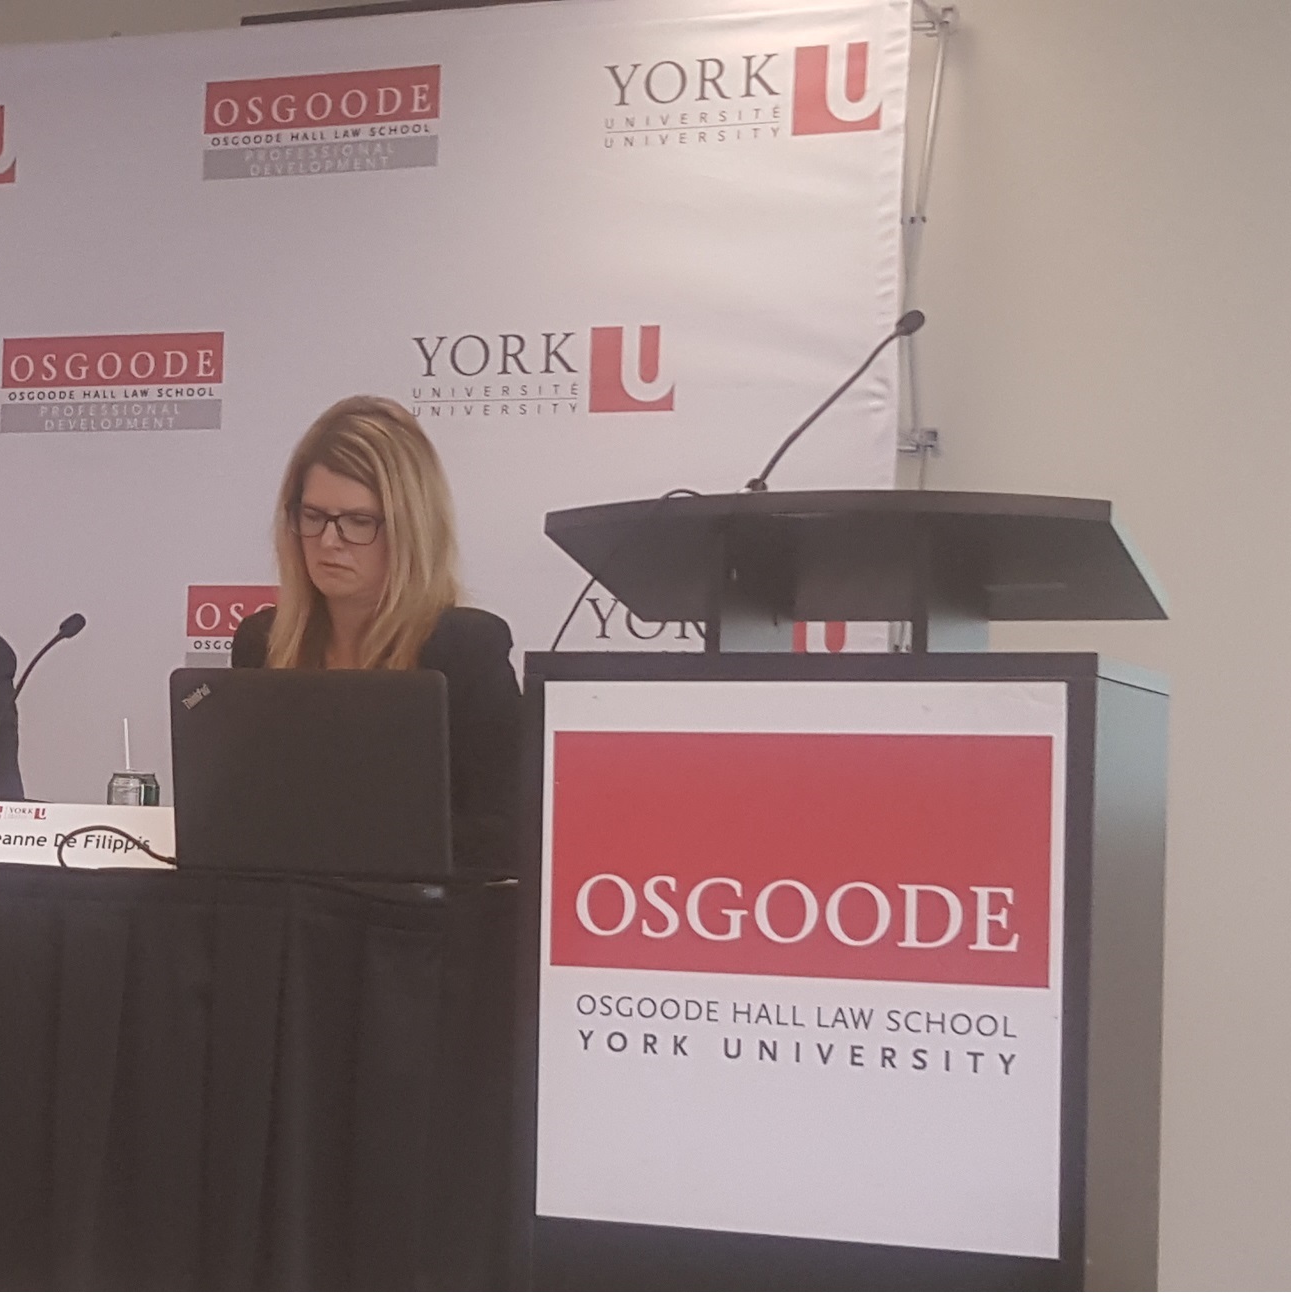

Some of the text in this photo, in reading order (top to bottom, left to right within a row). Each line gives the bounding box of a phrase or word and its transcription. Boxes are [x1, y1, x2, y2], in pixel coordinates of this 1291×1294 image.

[604, 54, 780, 106] YORK
[213, 84, 430, 127] OSGOODE
[605, 105, 780, 129] UNIVERSITÉ
[211, 124, 430, 146] OSGOODE HALL LAW SCHOOL
[604, 127, 780, 148] UNIVERSITY
[413, 332, 578, 377] YORK
[10, 350, 215, 382] OSGOODE
[9, 387, 215, 401] OSGOODE HALL LAW SCHOOL
[412, 382, 579, 399] UNIVERSITÉ
[39, 403, 181, 417] PROFESSIONAL
[412, 402, 578, 417] UNIVERSITY
[44, 417, 175, 430] DEVELOPMENT
[194, 641, 232, 650] OSGO
[54, 833, 77, 848] De
[83, 834, 150, 853] Filippis
[575, 873, 1020, 952] OSGOODE
[576, 994, 1017, 1038] OSGOODE HALL LAW SCHOOL
[577, 1029, 1017, 1076] YORK UNIVERSITY
